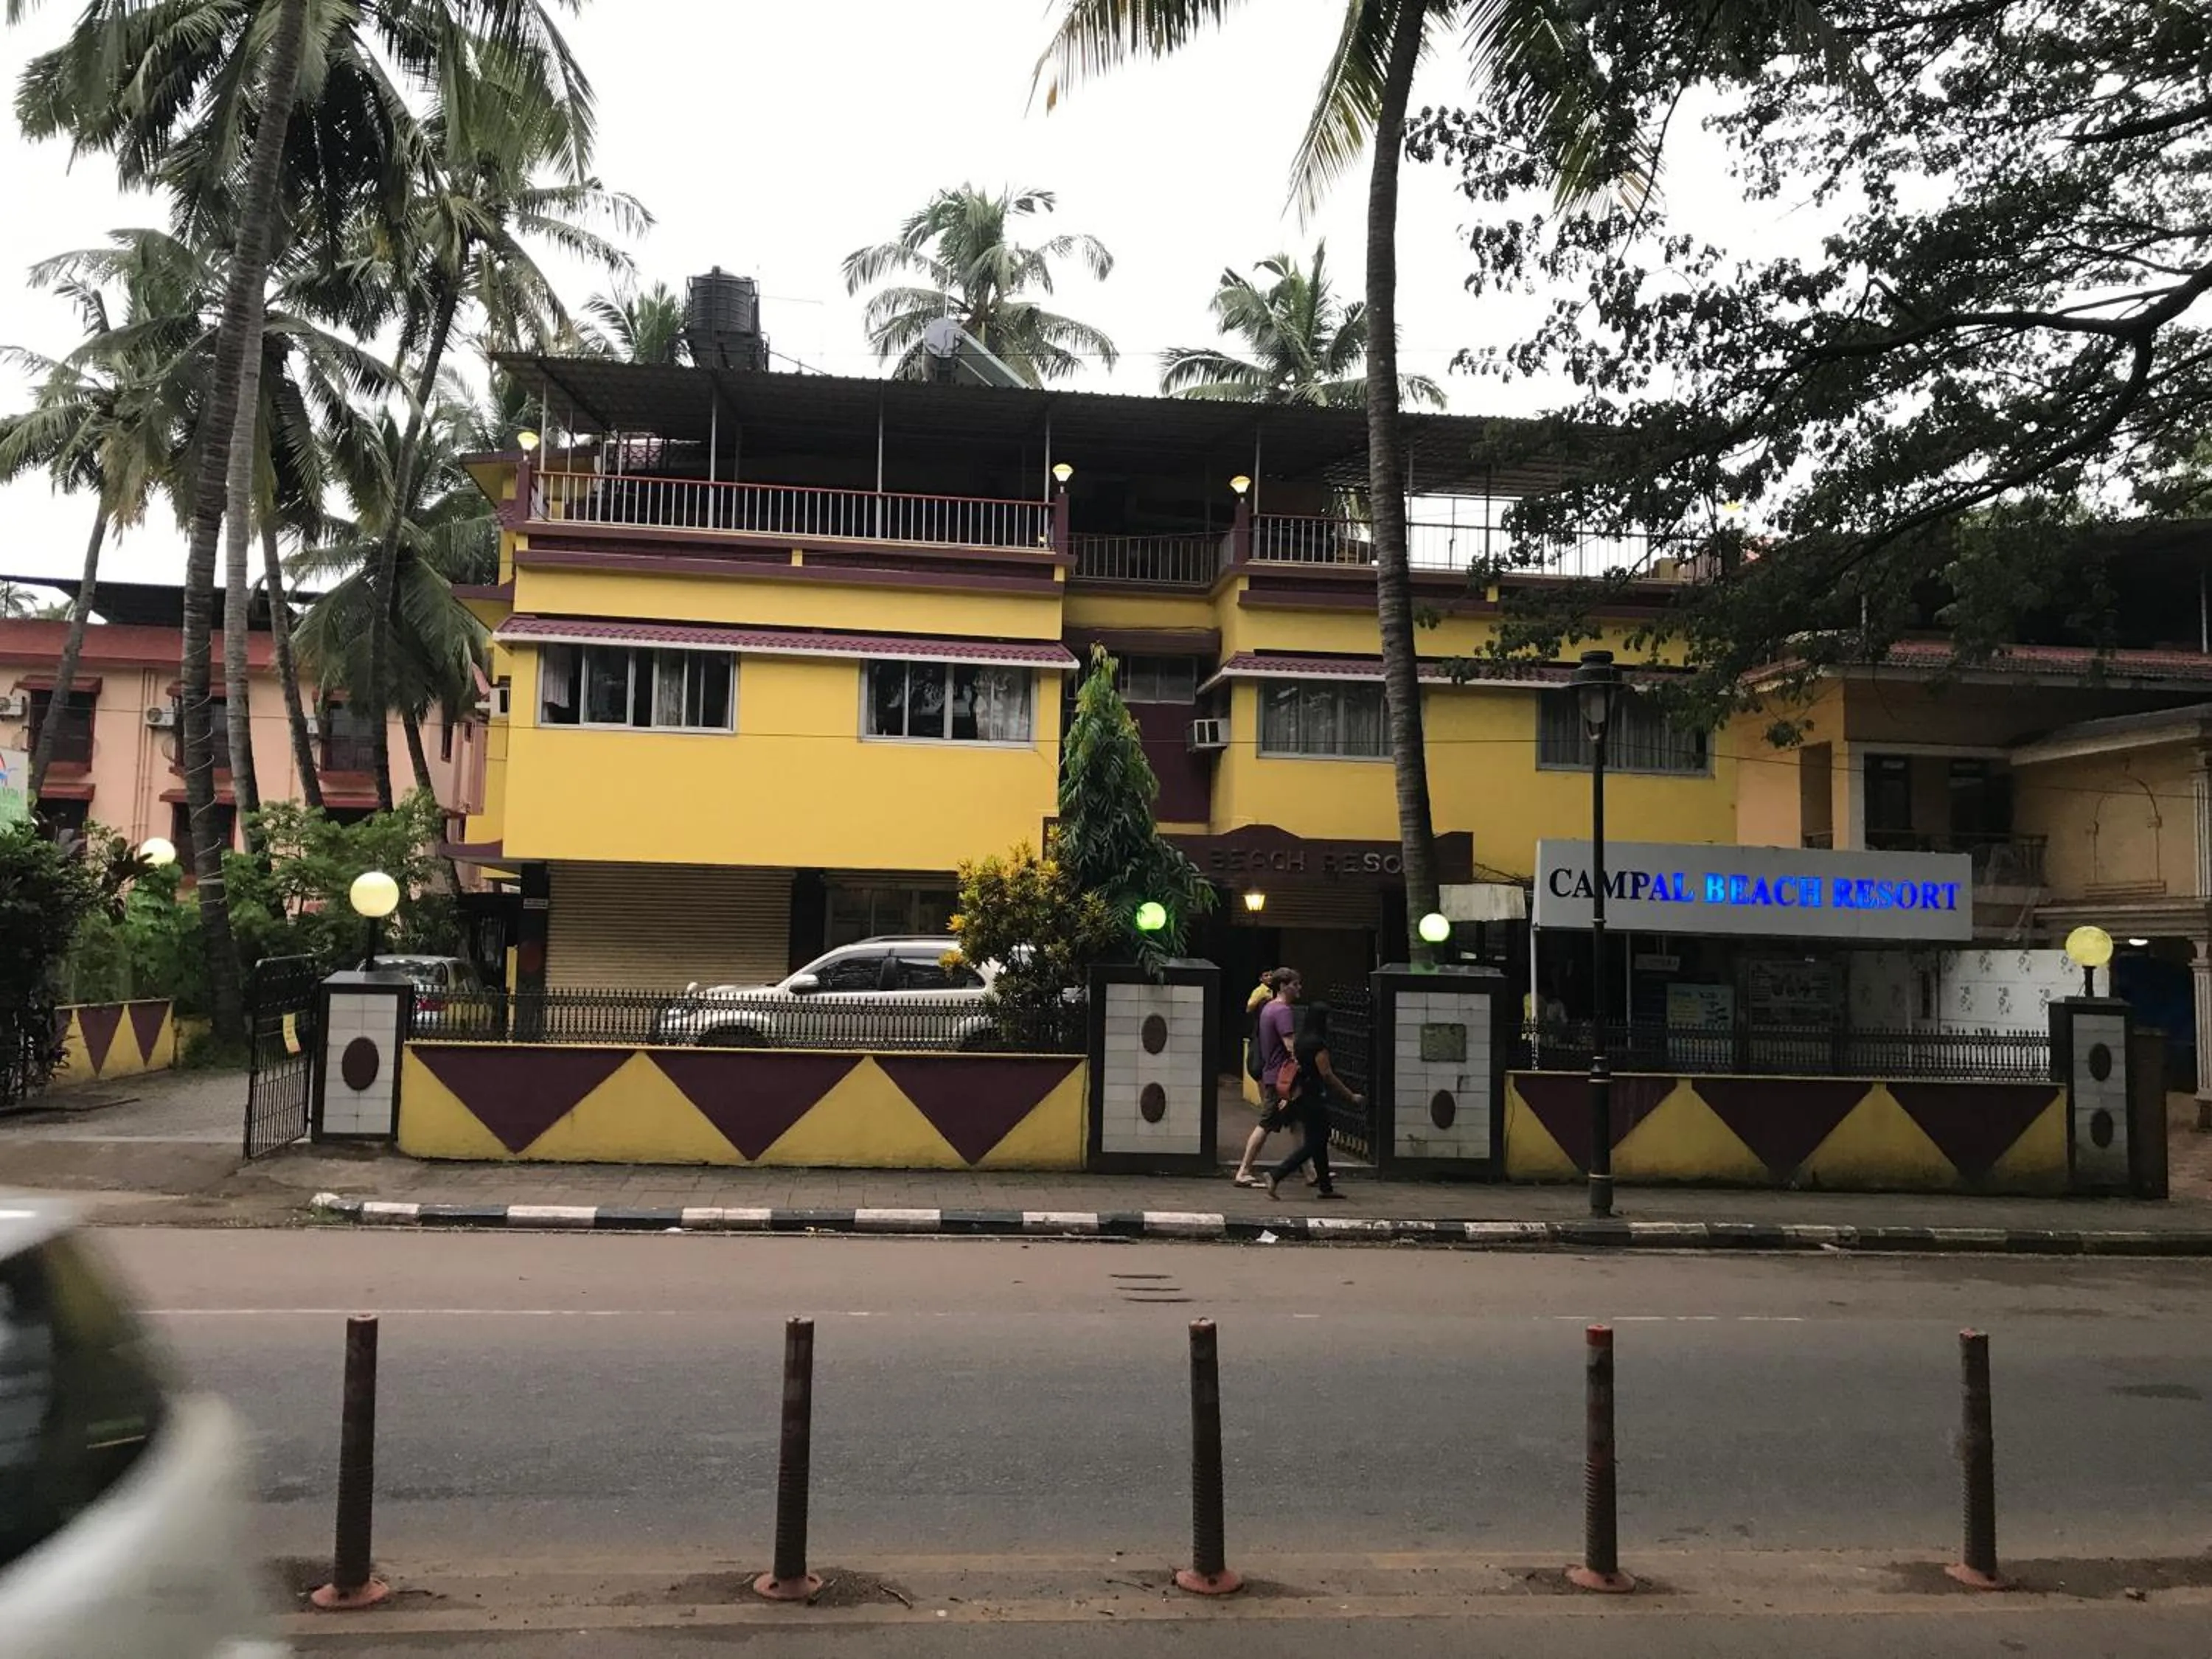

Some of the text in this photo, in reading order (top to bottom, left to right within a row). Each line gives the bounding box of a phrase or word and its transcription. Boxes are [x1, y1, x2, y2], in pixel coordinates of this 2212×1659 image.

[1211, 849, 1405, 874] BEACH RESO
[1549, 868, 1960, 911] CAMPAL BEACH RESORT
